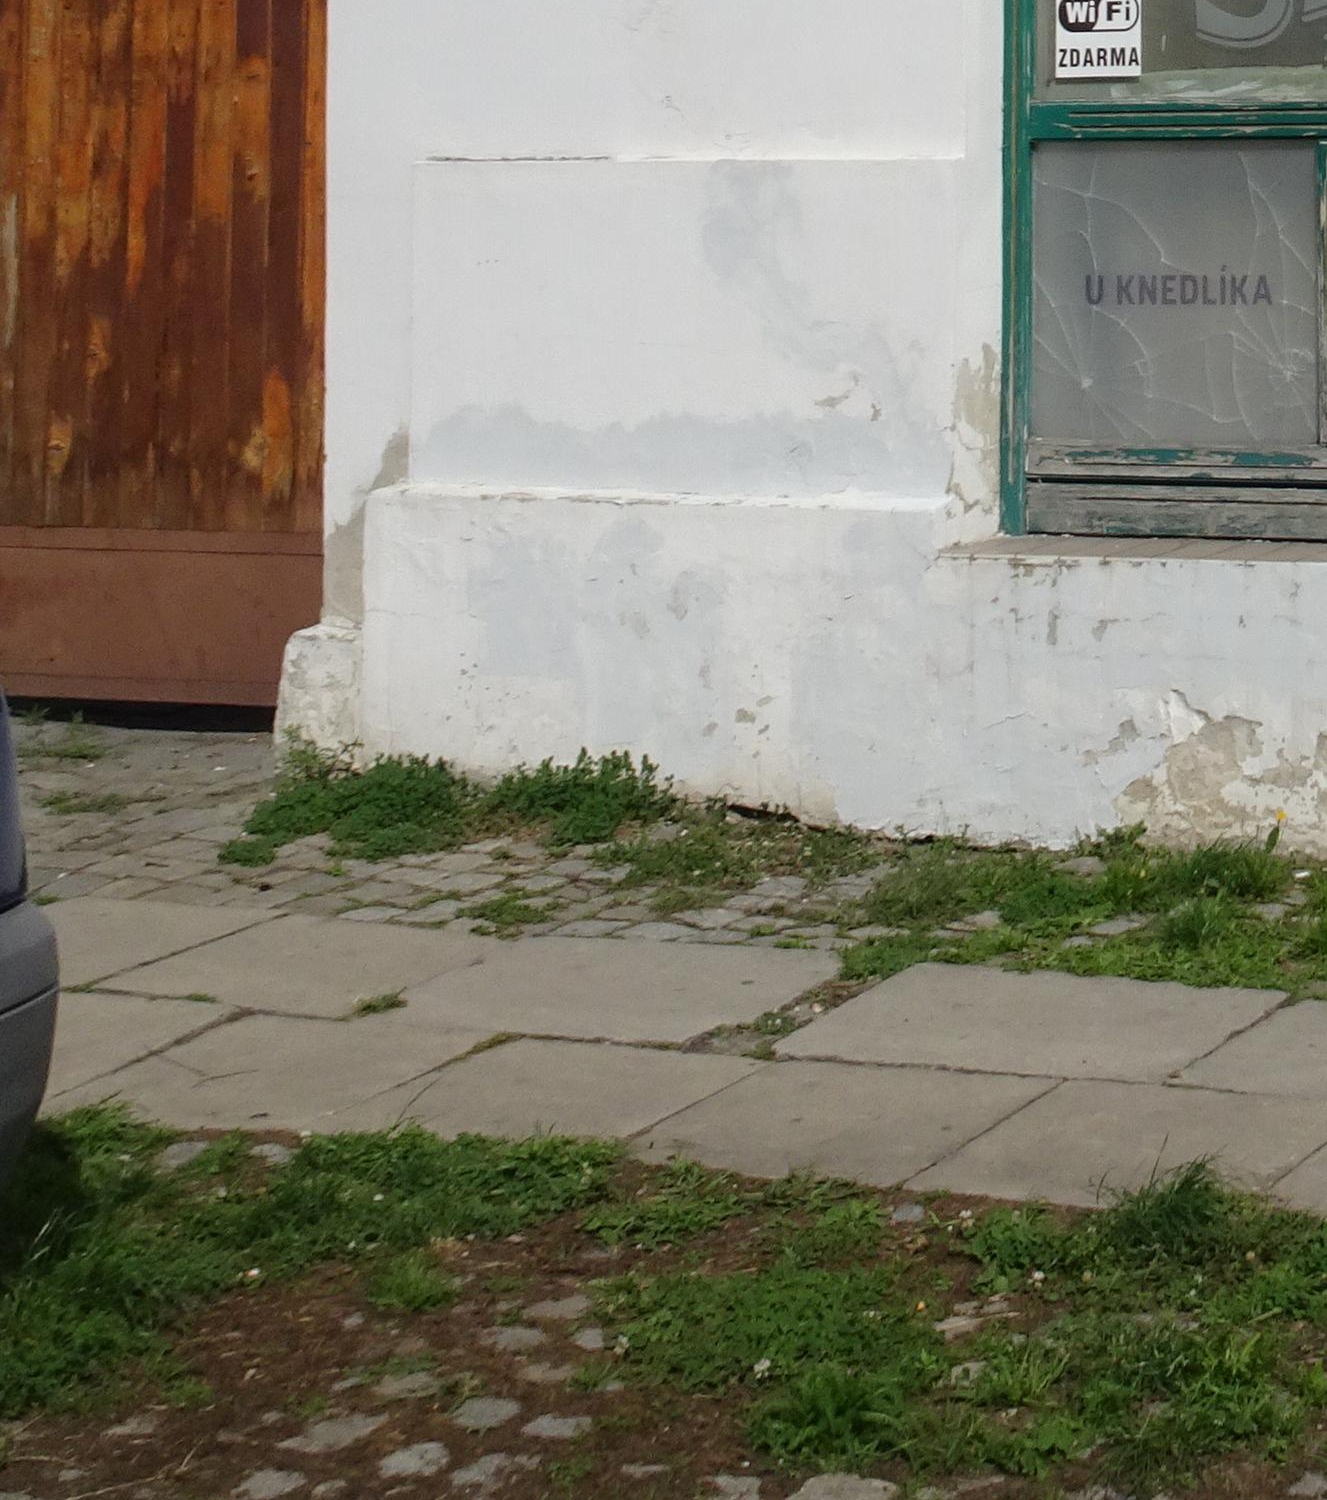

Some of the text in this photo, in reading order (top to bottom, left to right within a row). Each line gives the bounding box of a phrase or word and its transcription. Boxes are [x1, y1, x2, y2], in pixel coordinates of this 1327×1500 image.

[1058, 47, 1140, 68] ZDARMA
[1084, 263, 1273, 308] U KNEDLÍKA
